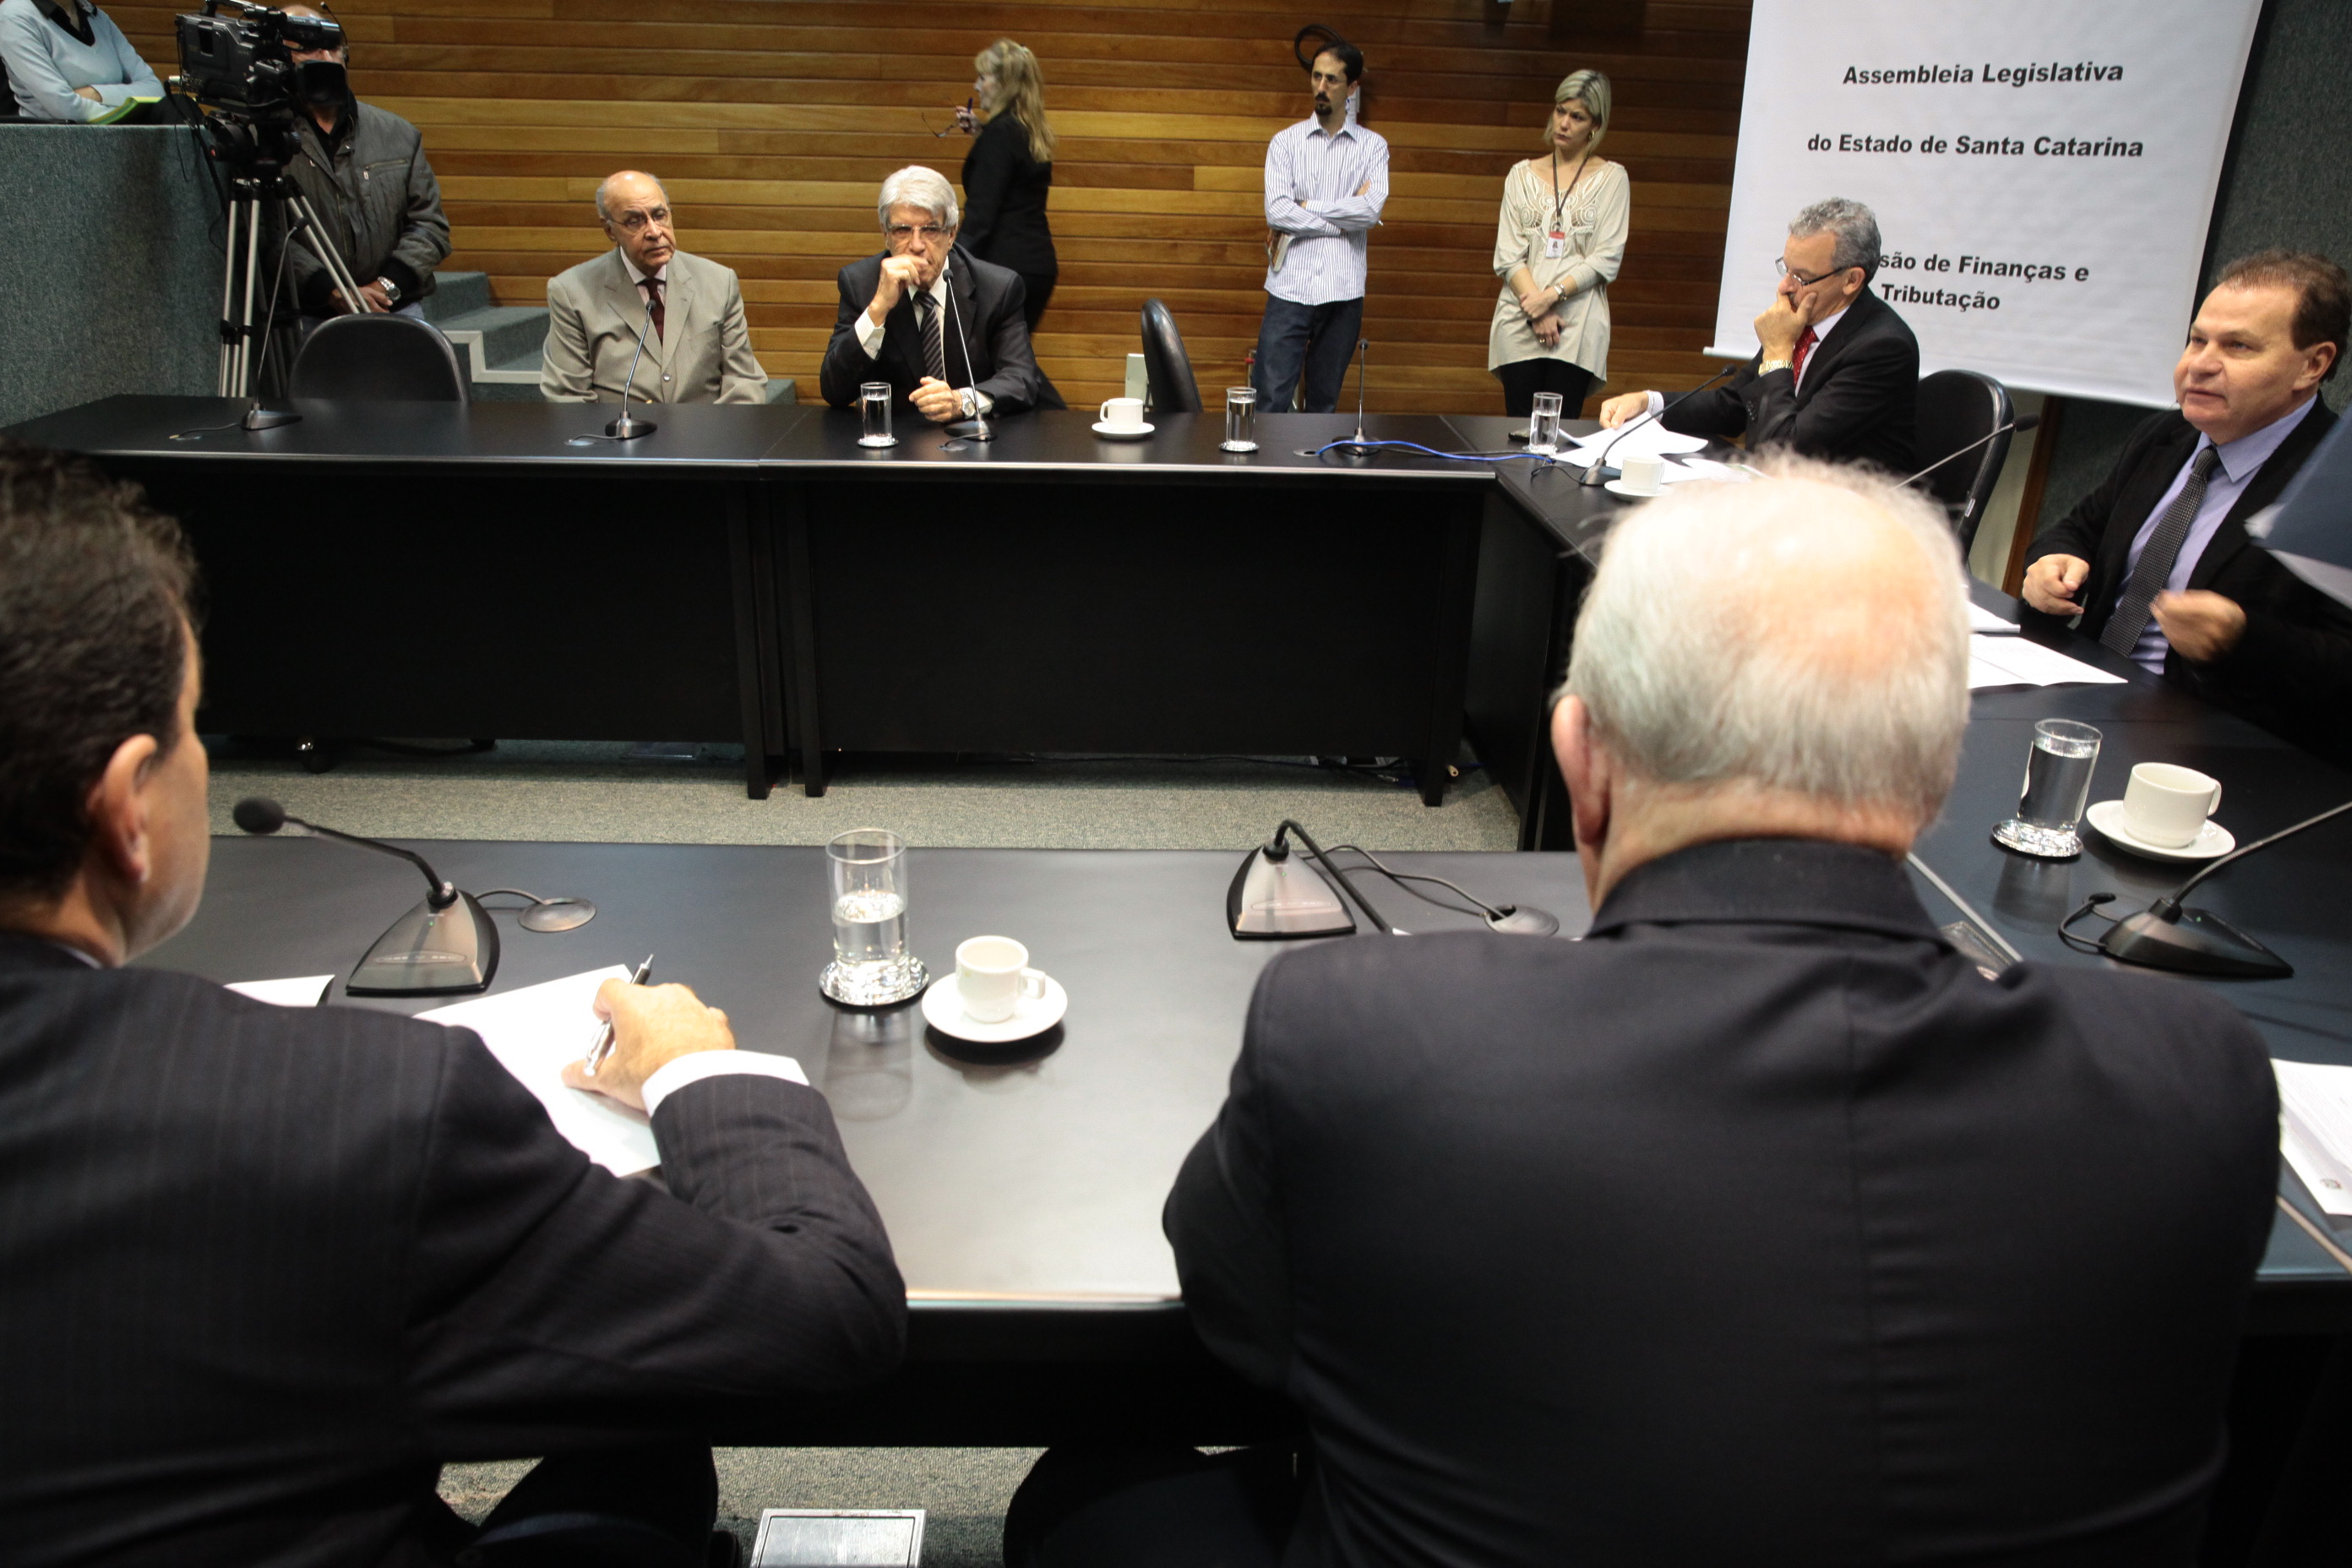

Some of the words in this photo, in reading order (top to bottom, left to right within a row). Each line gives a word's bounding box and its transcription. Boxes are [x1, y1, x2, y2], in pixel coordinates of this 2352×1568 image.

[1843, 64, 1974, 84] Assembleia
[1982, 61, 2125, 88] Legislativa
[1808, 133, 1832, 151] do
[1839, 134, 1913, 153] Estado
[1921, 135, 1947, 154] de
[1956, 136, 2025, 155] Santa
[2034, 137, 2143, 157] Catarina
[1925, 253, 1951, 272] de
[1958, 255, 2066, 282] Finanças
[2075, 267, 2089, 282] e
[1881, 284, 2001, 312] Tributação
